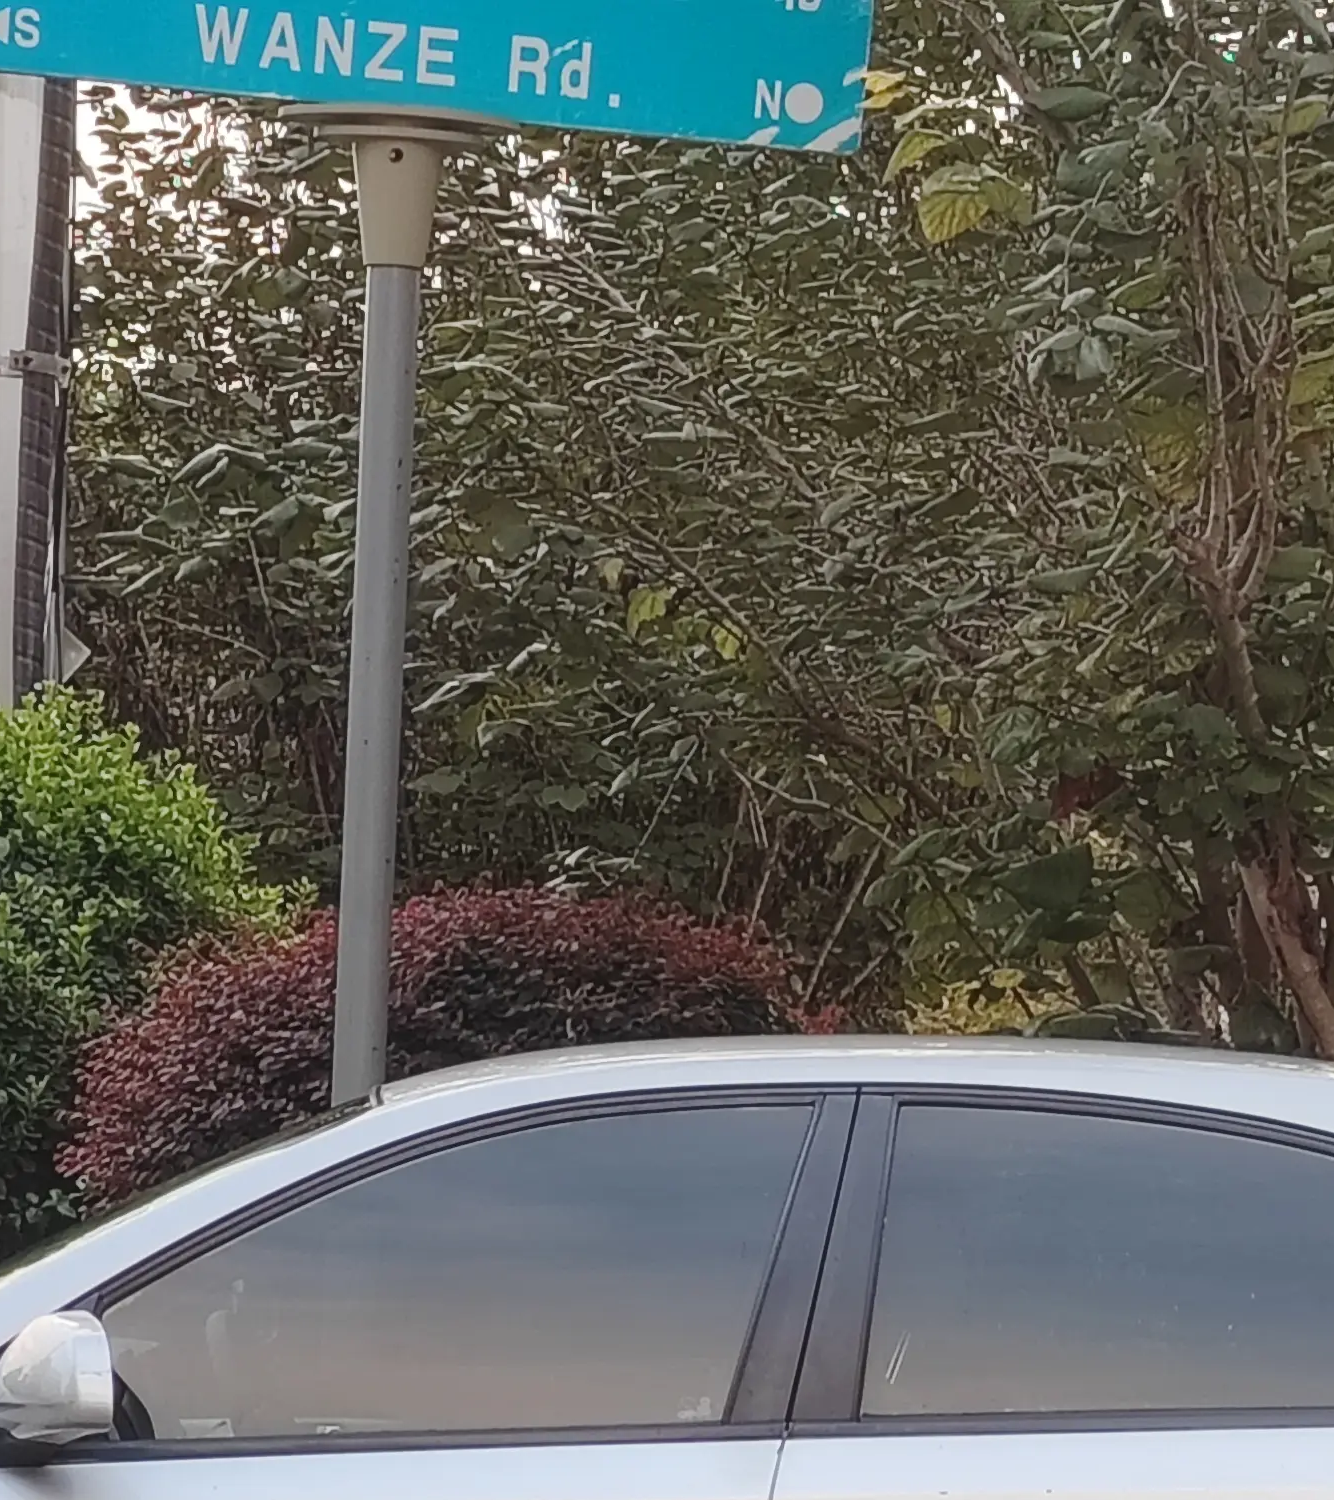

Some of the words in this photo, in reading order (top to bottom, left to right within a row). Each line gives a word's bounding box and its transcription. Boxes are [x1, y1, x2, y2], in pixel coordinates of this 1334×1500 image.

[13, 8, 41, 49] S
[195, 3, 459, 87] WANZE
[508, 34, 620, 109] Rd.
